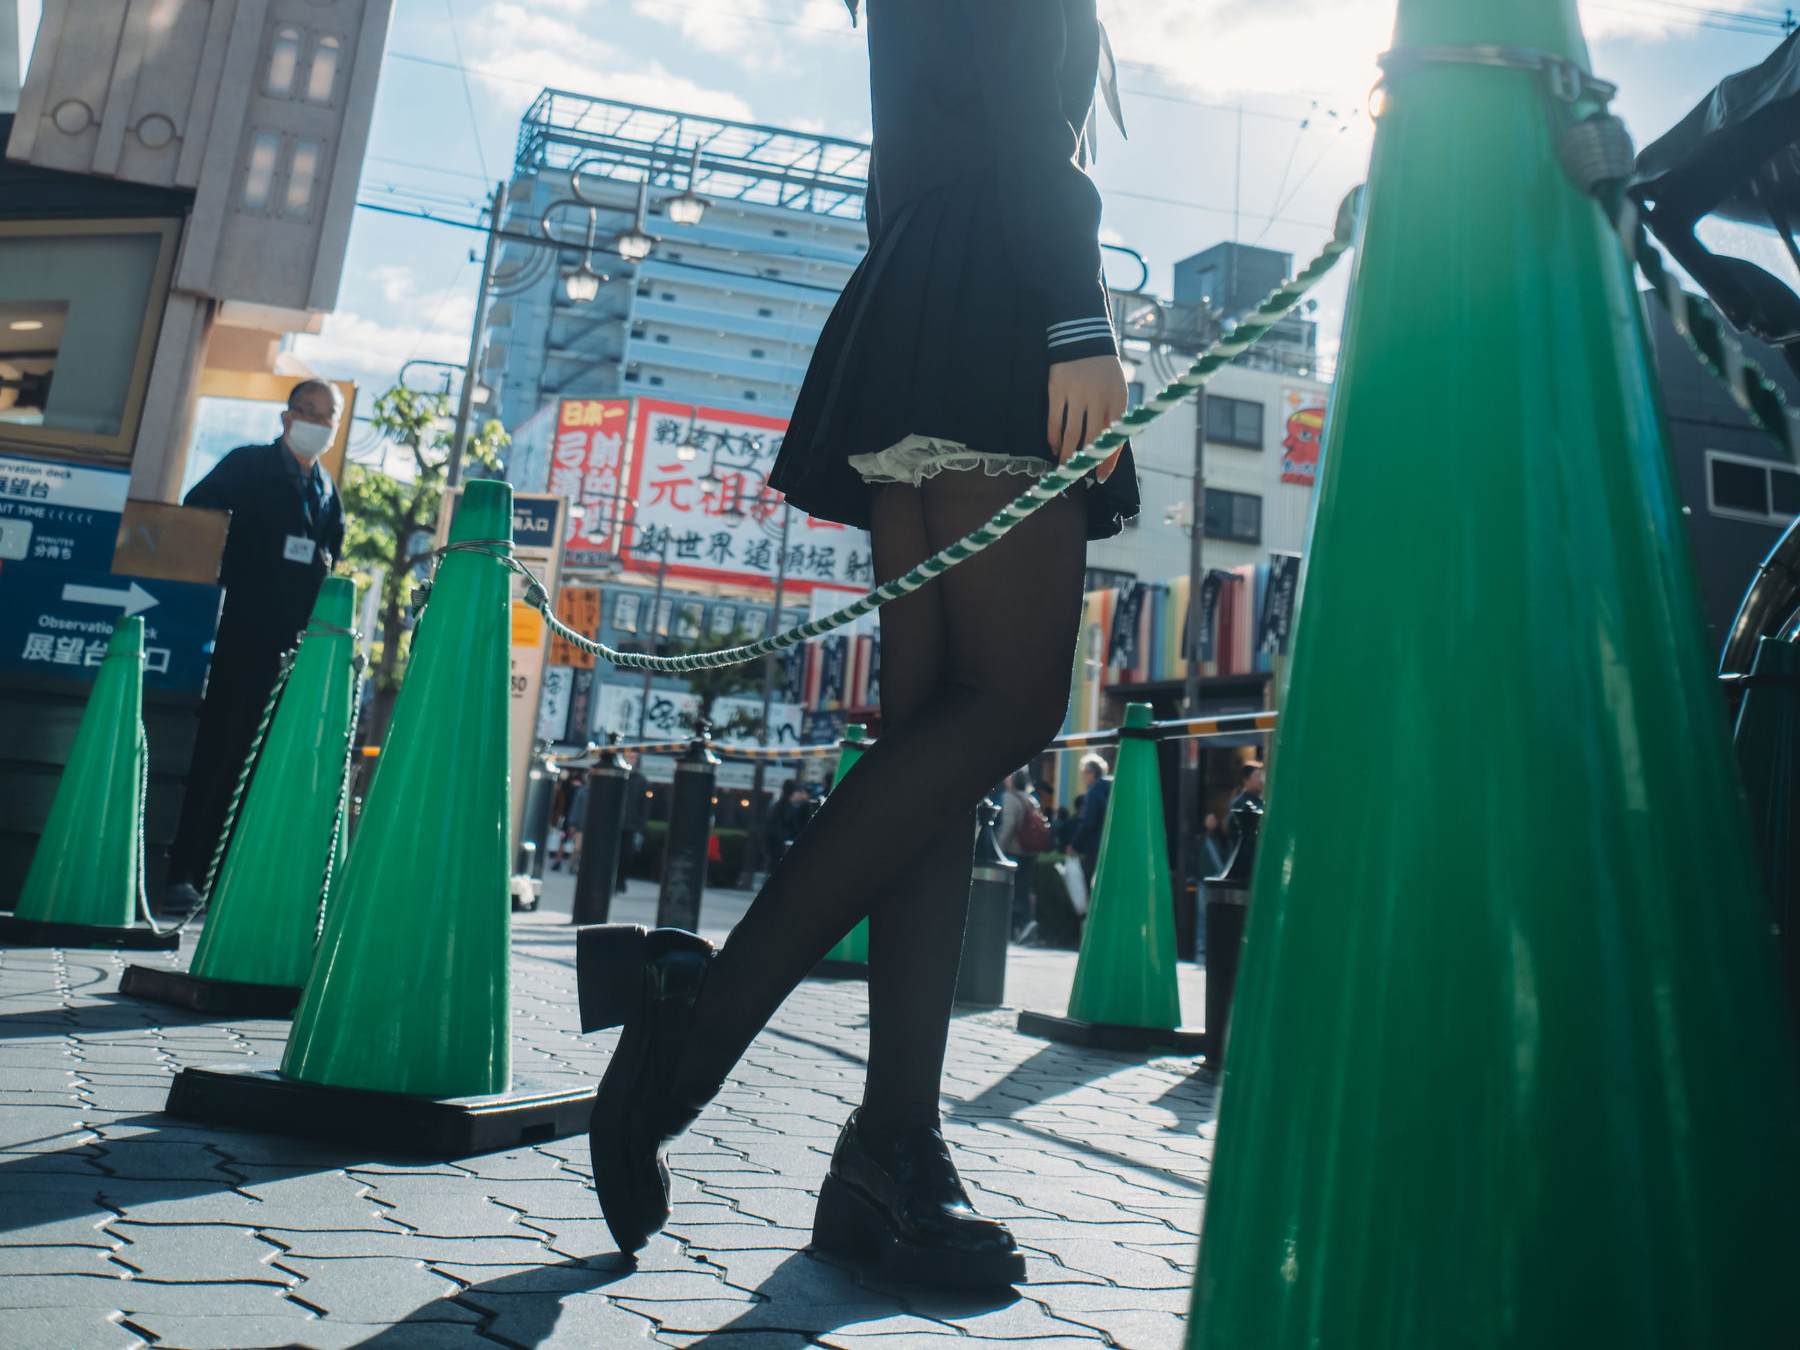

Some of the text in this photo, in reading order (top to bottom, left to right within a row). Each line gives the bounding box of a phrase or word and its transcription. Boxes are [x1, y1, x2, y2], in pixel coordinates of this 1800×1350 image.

[562, 401, 625, 426] 日本一
[18, 505, 46, 518] TIME
[38, 614, 114, 635] Observatio
[22, 632, 171, 673] 展望台口
